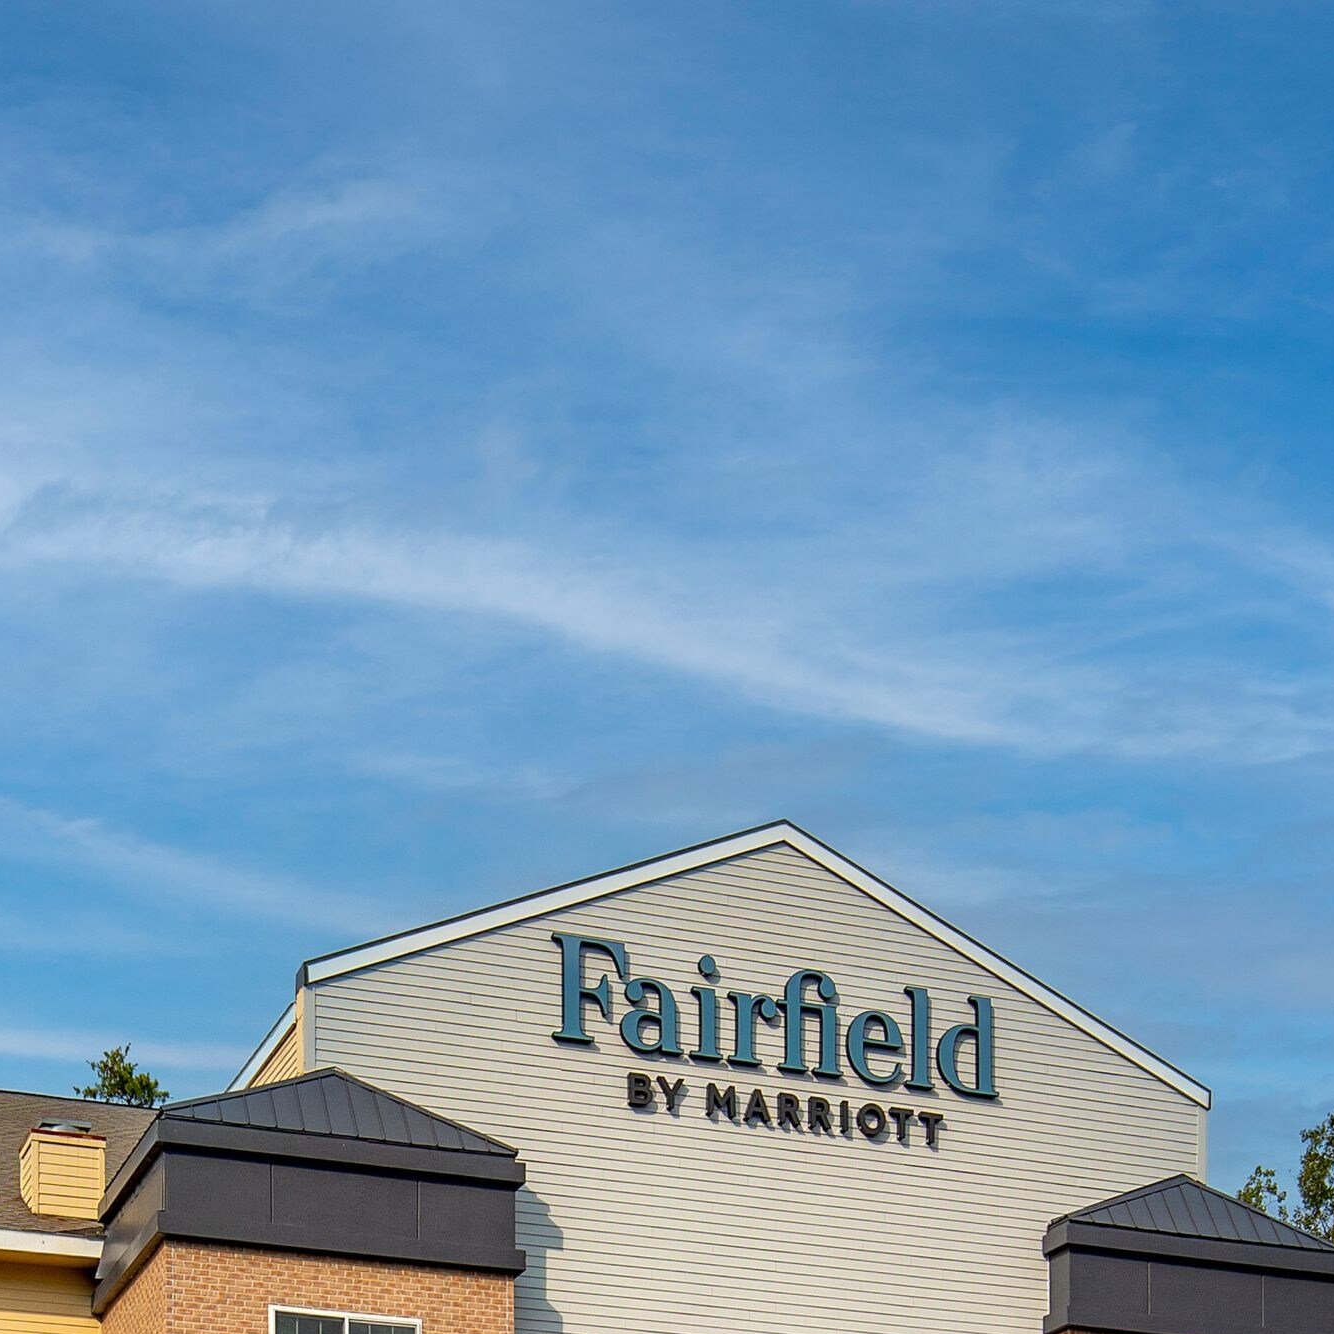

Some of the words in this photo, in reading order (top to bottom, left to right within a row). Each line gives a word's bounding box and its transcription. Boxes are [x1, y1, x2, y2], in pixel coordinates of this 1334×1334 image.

[551, 931, 1000, 1099] Fairfield
[627, 1072, 684, 1112] BY
[705, 1083, 944, 1146] MARRIOTT
